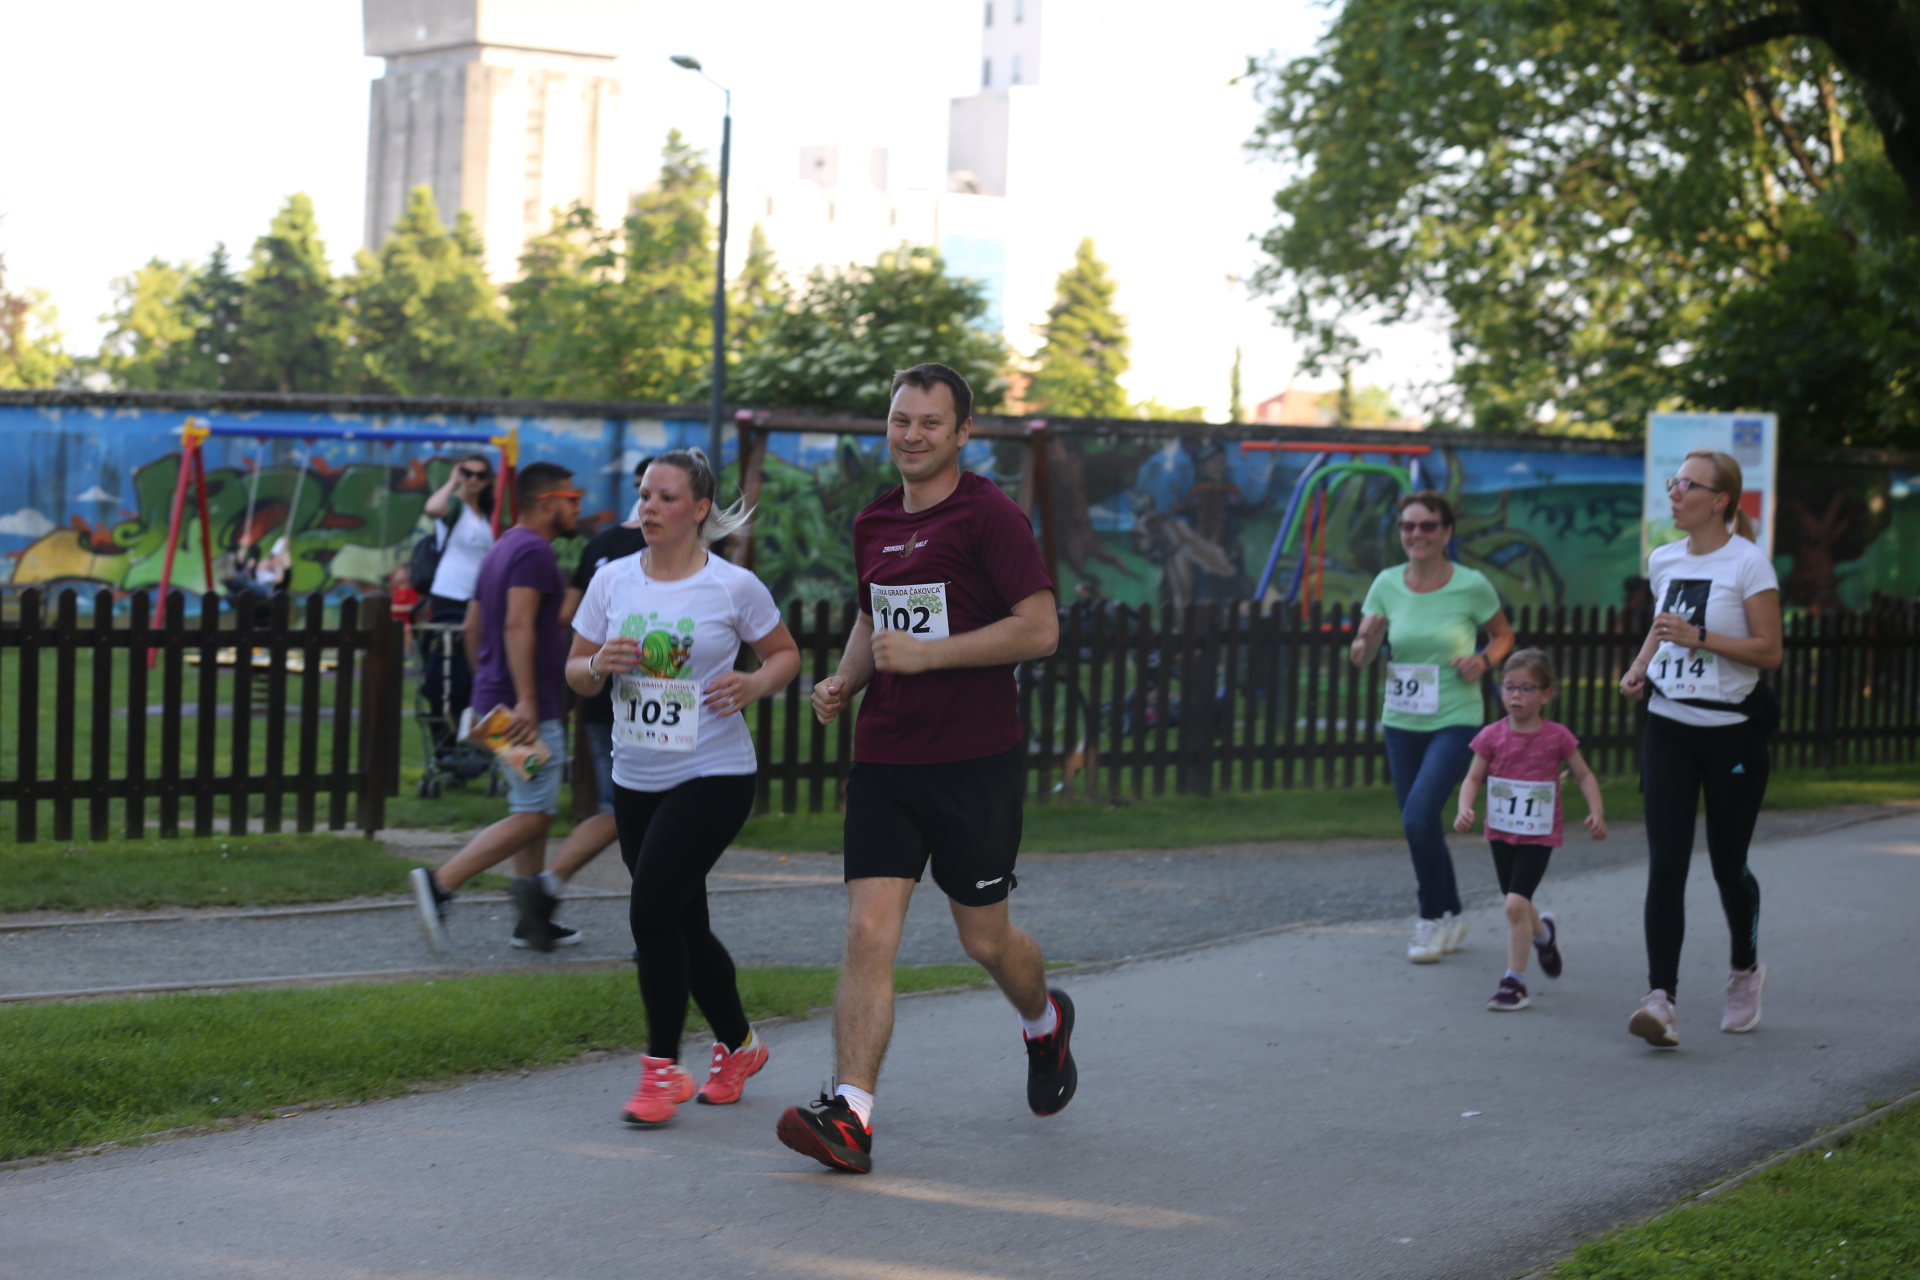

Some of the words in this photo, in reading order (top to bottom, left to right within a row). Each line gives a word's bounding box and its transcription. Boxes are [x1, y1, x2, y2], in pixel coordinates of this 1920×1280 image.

[882, 544, 905, 553] ZRINSKI
[914, 539, 929, 549] HALF
[888, 589, 908, 597] GRADA
[880, 606, 931, 634] 102
[1660, 657, 1706, 680] 114
[1392, 678, 1420, 698] 39
[628, 696, 682, 726] 103
[1508, 795, 1535, 817] 11
